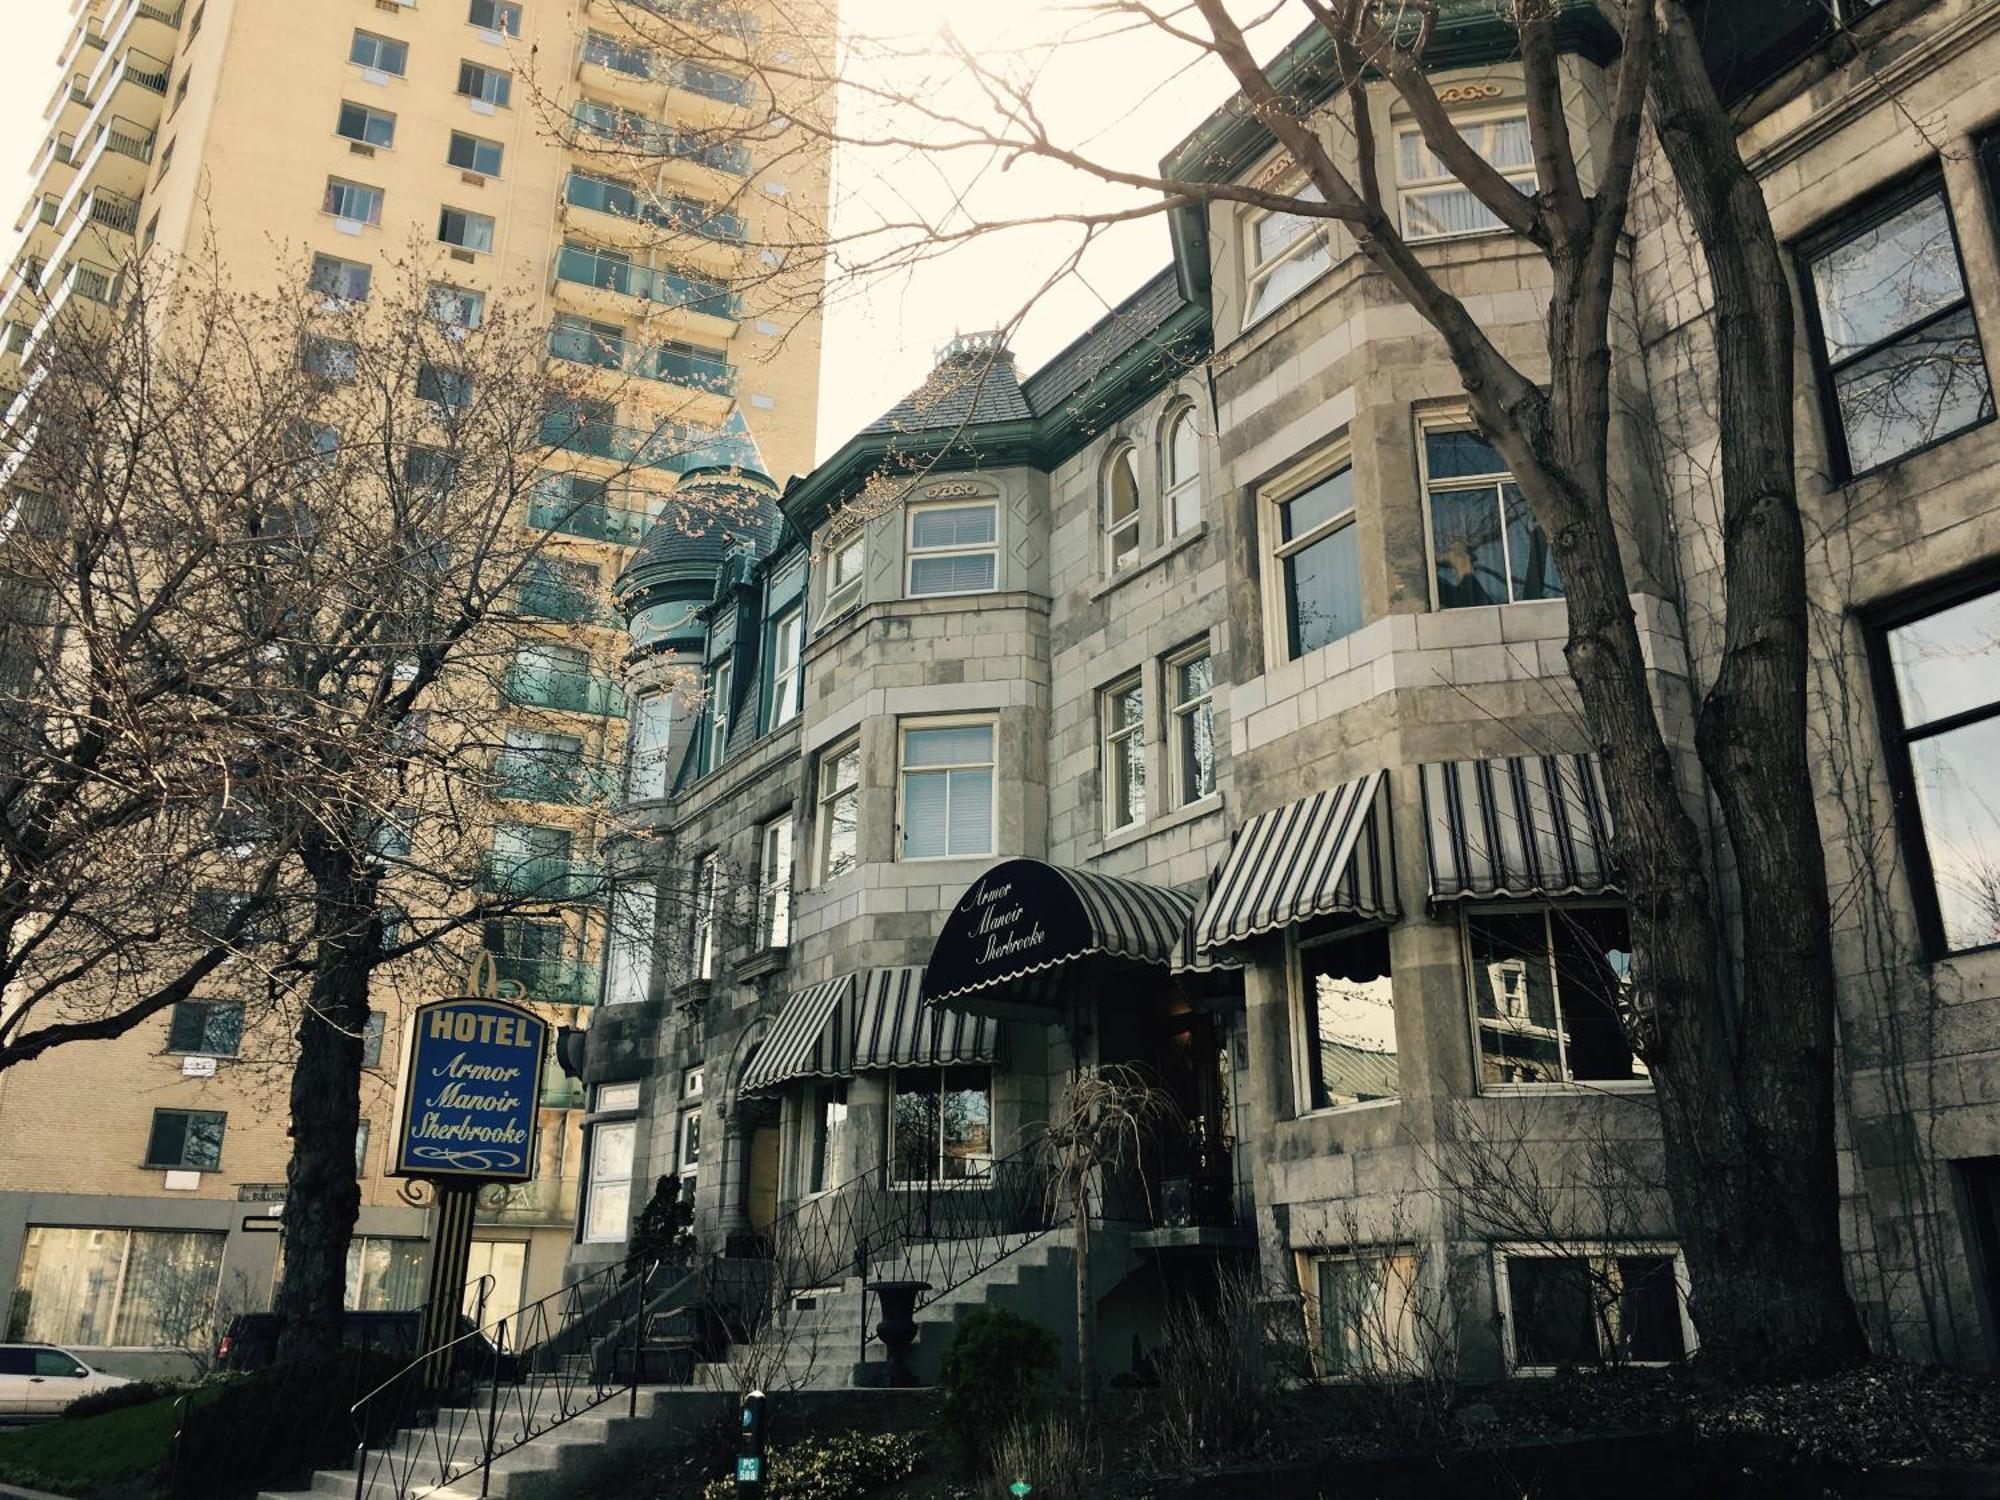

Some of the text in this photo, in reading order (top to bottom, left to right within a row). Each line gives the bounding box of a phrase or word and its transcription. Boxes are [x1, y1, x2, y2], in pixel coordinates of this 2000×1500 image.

[961, 879, 1012, 912] Armor
[968, 902, 1023, 938] Manoir
[975, 921, 1045, 965] Sherbrooke
[430, 1010, 532, 1047] HOTEL
[432, 1052, 520, 1081] Armor
[426, 1082, 521, 1112] Manoir
[412, 1112, 527, 1143] Sherbrooke
